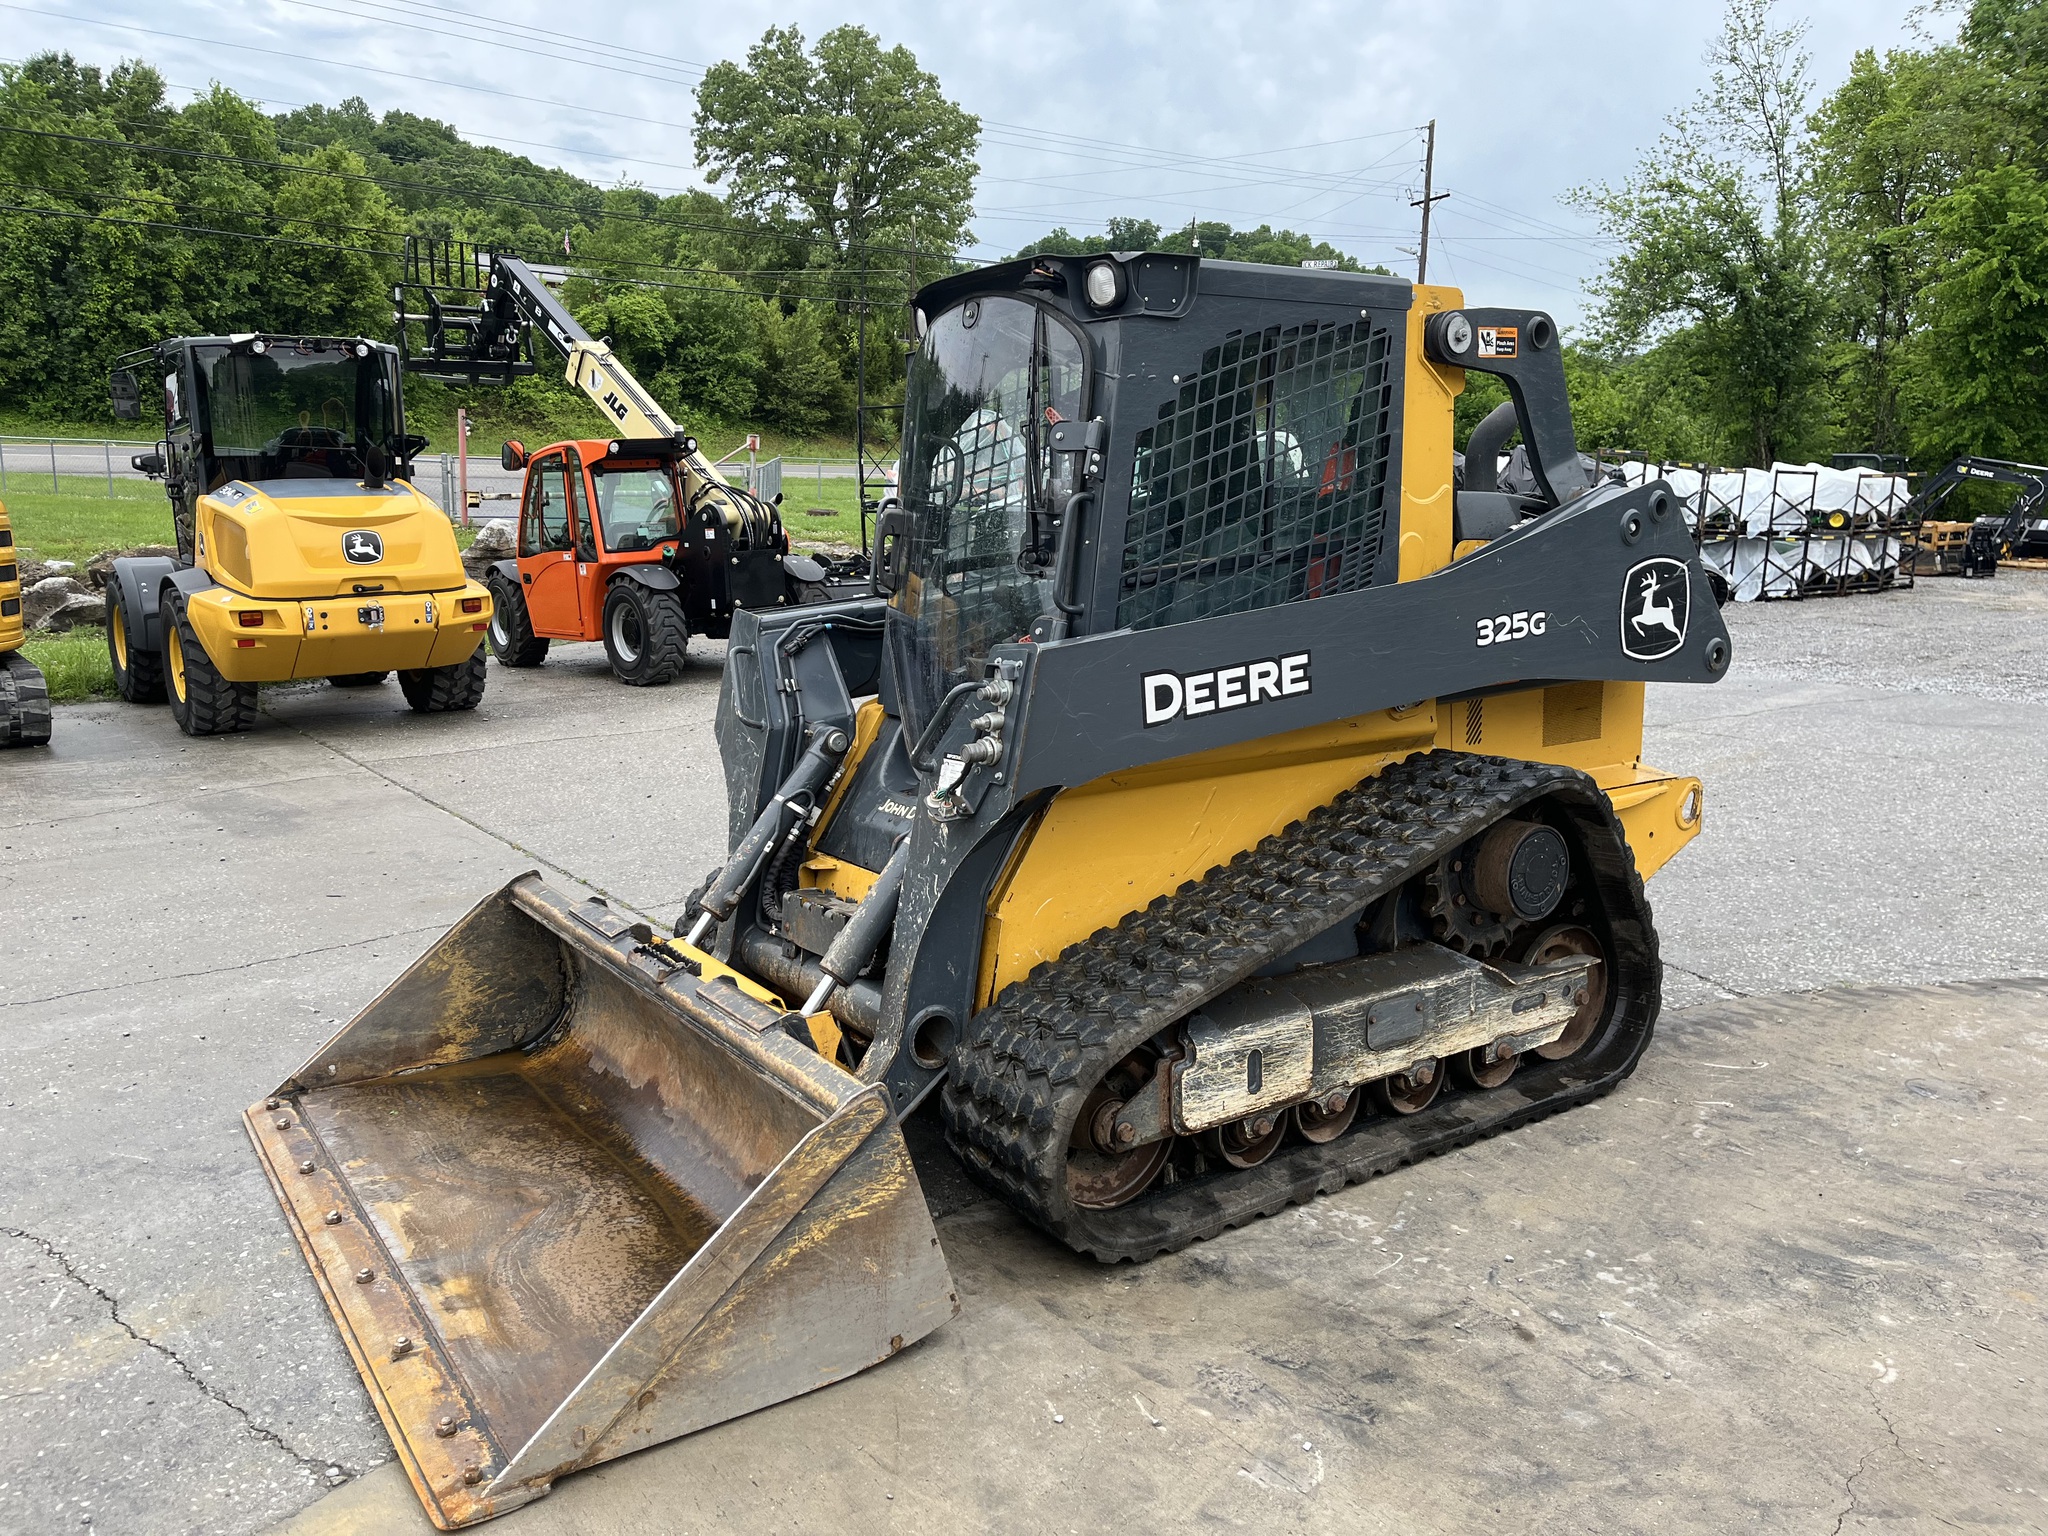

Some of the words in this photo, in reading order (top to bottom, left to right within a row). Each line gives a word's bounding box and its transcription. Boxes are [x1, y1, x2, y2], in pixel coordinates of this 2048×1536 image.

[603, 391, 629, 421] JLG
[1970, 467, 1995, 478] DEERE
[1476, 611, 1546, 646] 325G
[1143, 653, 1310, 724] DEERE
[877, 798, 909, 817] JOHN
